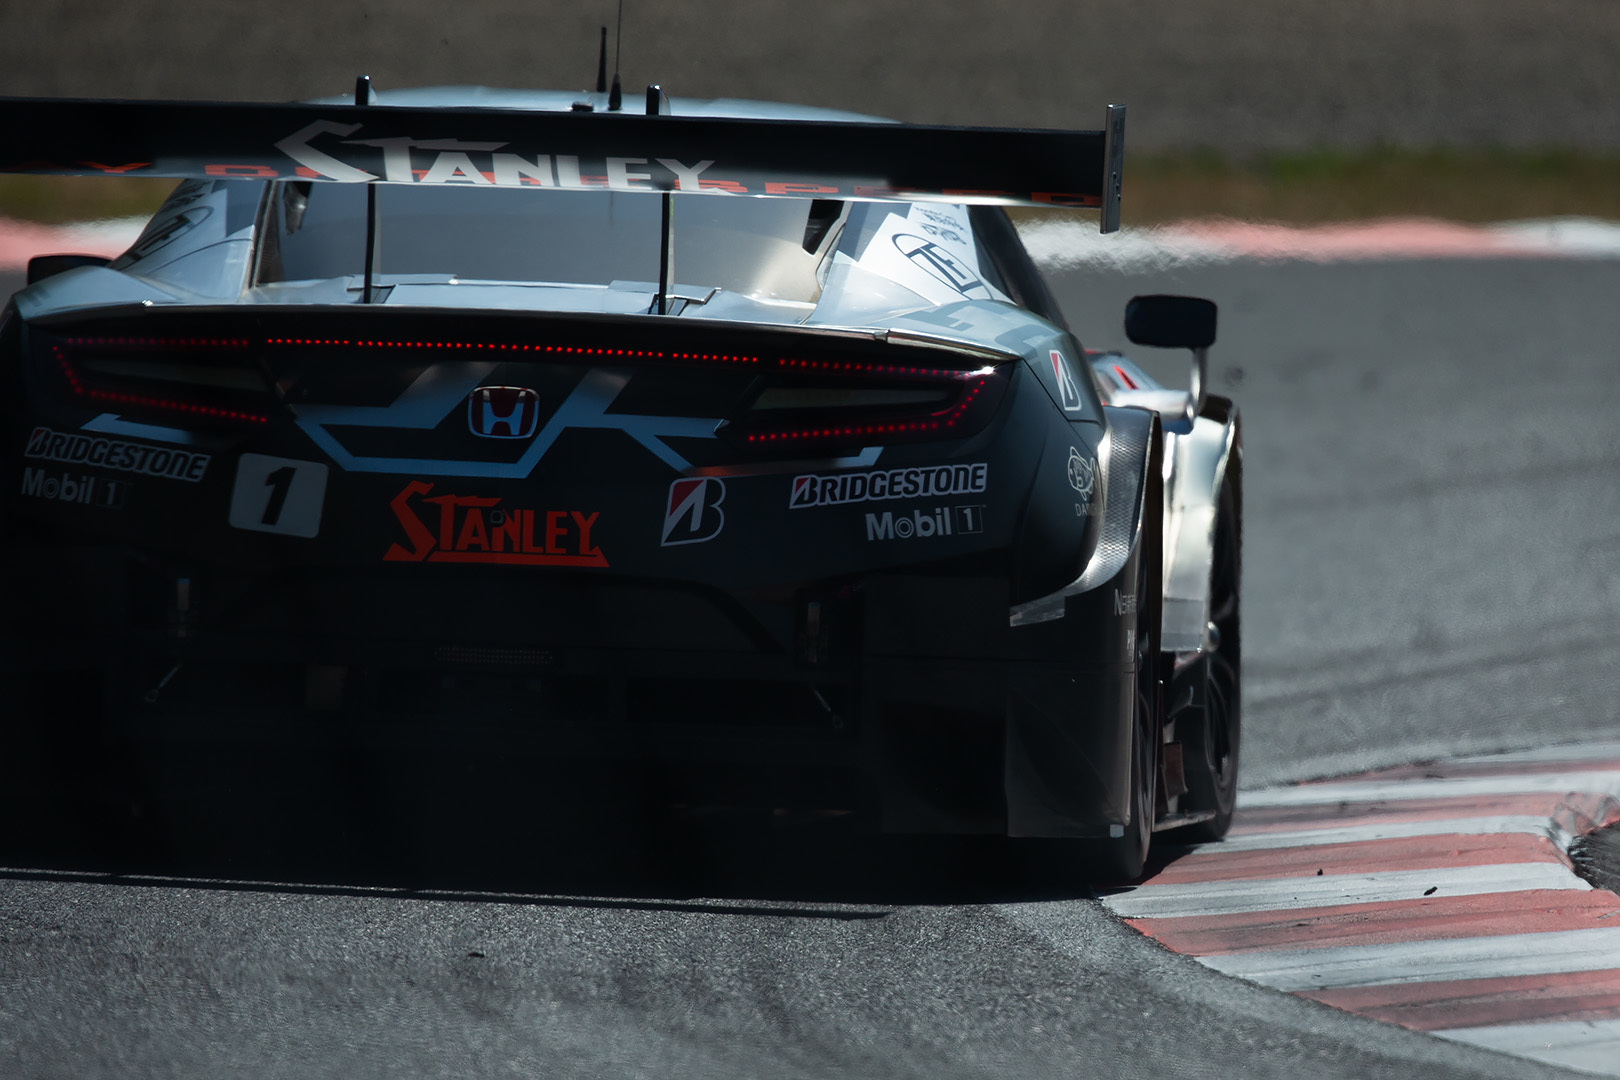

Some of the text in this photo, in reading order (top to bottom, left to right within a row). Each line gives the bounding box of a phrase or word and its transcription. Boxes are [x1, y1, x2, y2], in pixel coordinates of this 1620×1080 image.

[273, 119, 718, 194] STANLEY
[24, 426, 212, 483] BRIDGESTONE
[21, 467, 96, 505] Mobil
[261, 466, 297, 526] 1
[789, 463, 988, 509] BRIDGESTONE
[383, 480, 610, 568] STANLEY
[865, 507, 952, 541] Mobil
